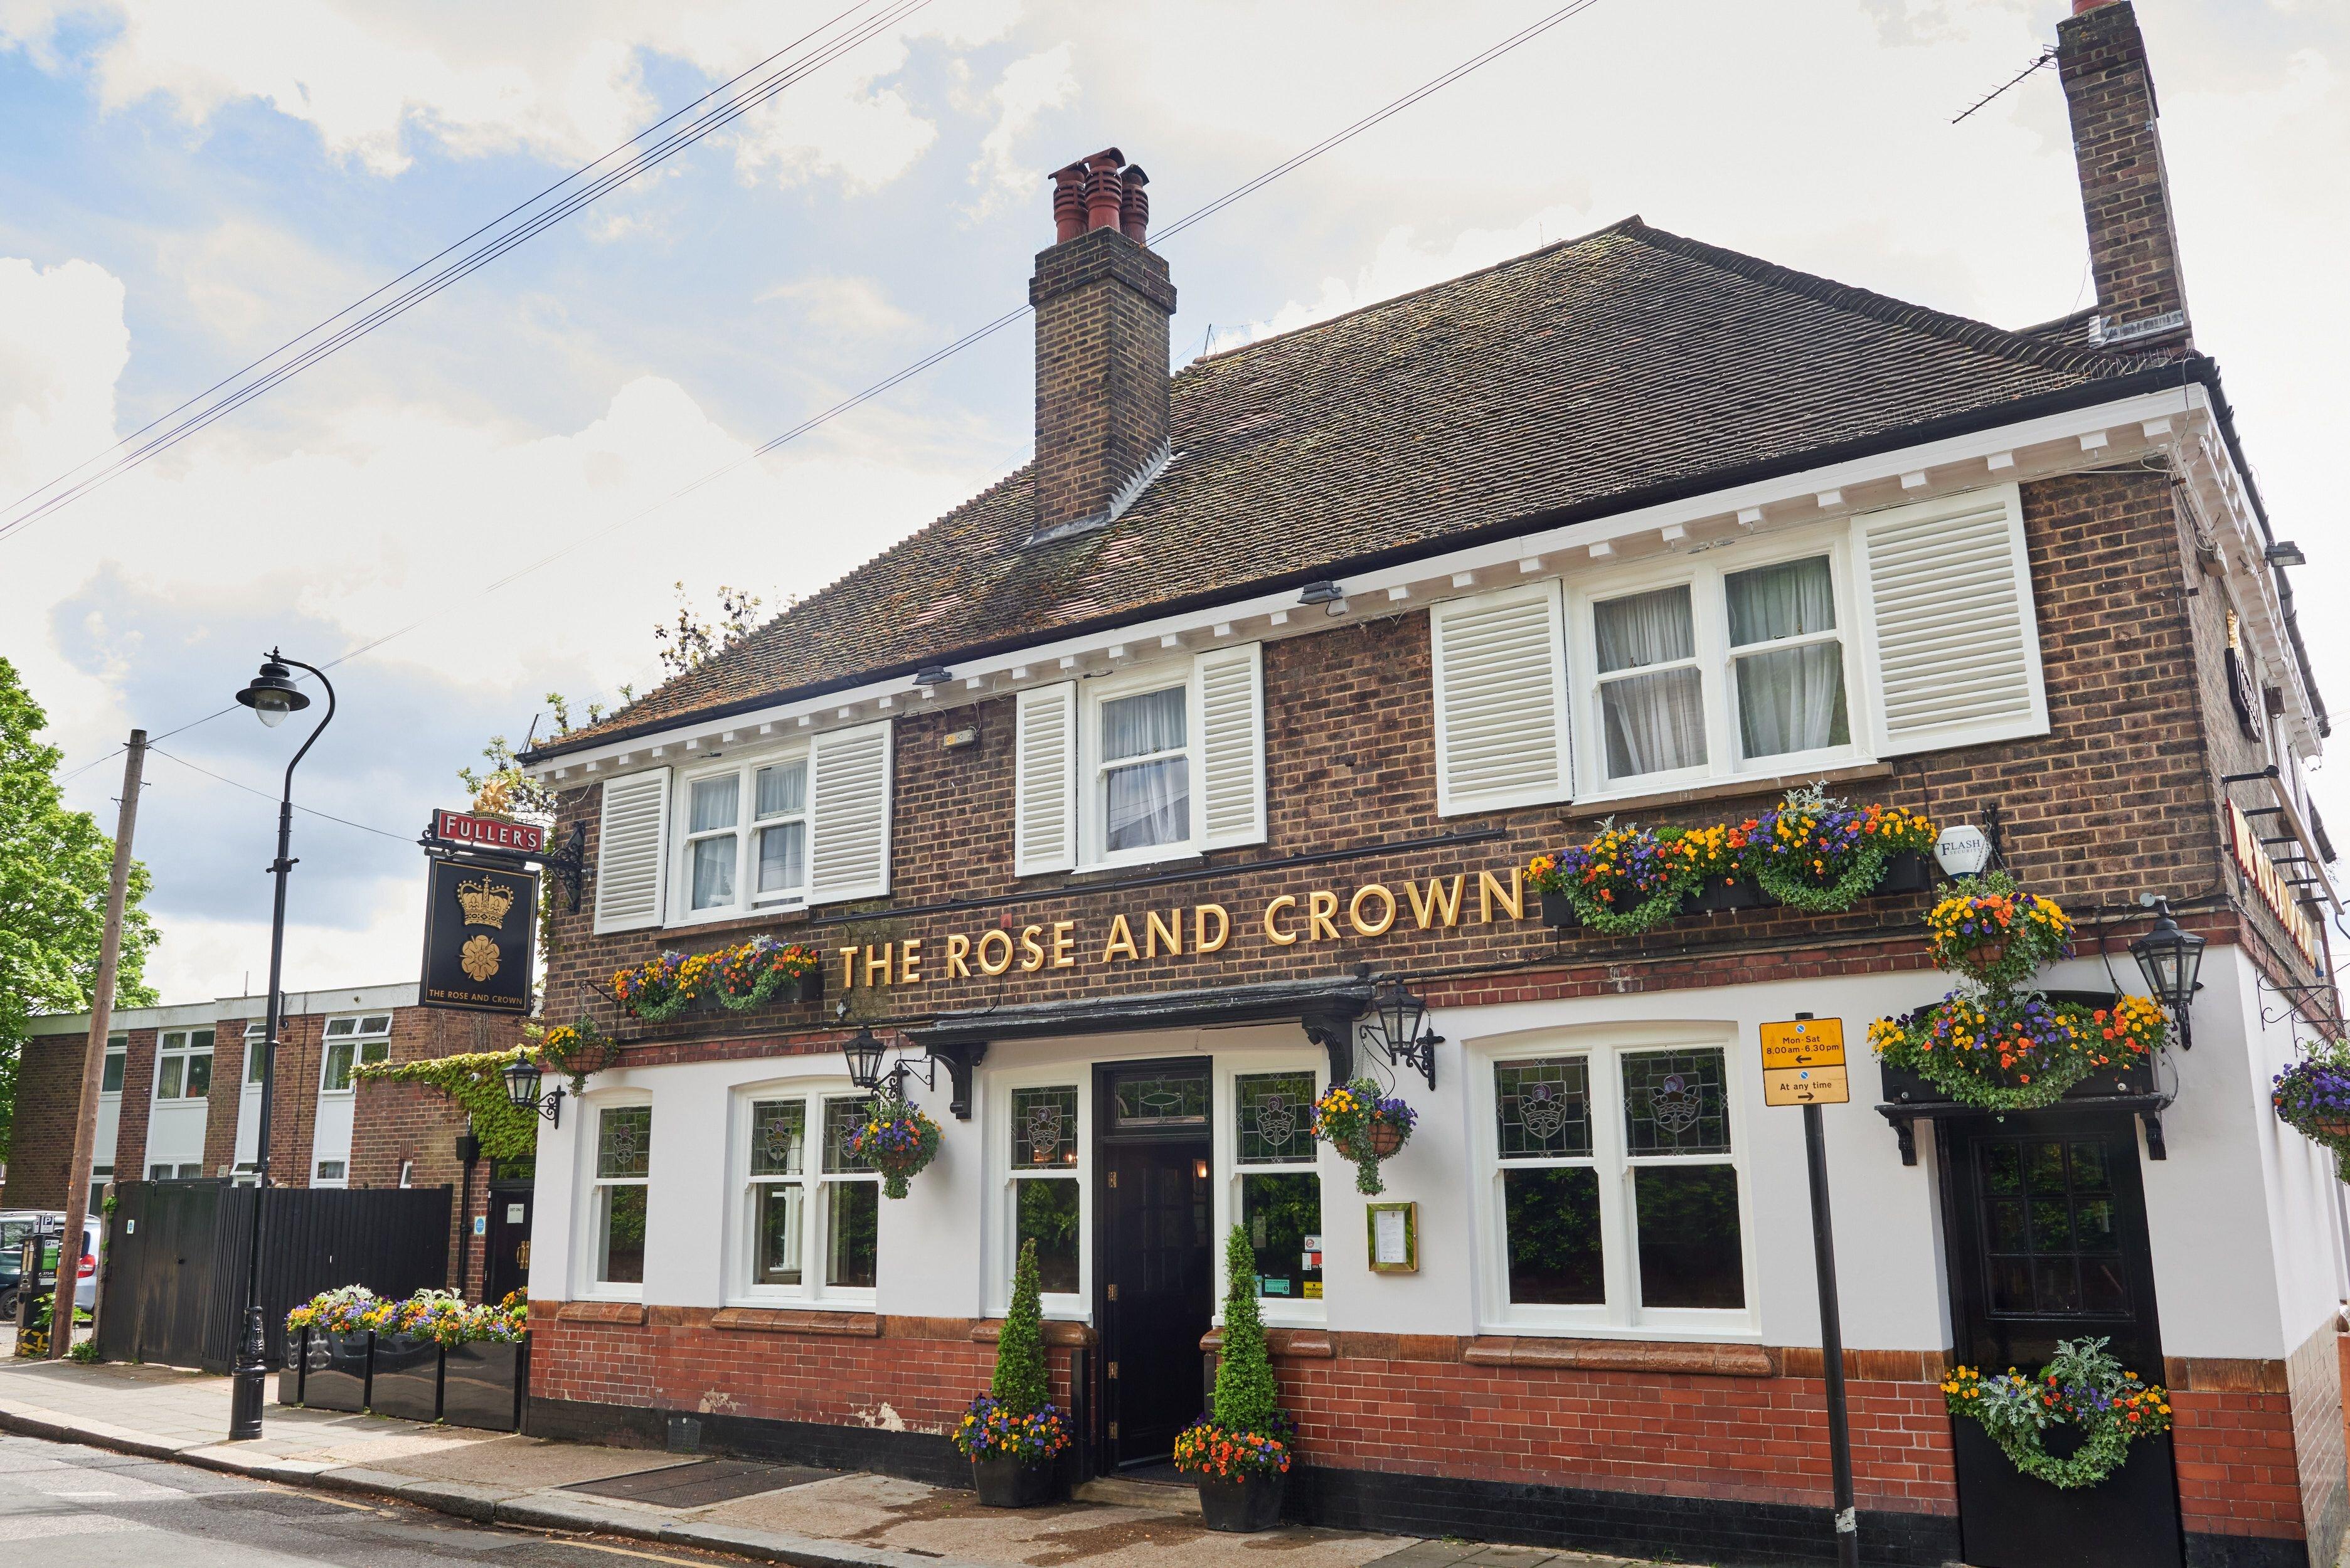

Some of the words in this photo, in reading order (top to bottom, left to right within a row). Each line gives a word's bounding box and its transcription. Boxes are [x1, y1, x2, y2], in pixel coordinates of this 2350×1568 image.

[445, 815, 537, 847] FULLER'S
[1940, 839, 1980, 856] FLASH
[839, 939, 921, 988] THE
[947, 921, 1075, 979] ROSE
[1102, 904, 1230, 963] AND
[1263, 867, 1524, 946] CROWN
[429, 989, 445, 997] THE
[447, 991, 469, 1000] ROSE
[471, 993, 489, 1002] AND
[492, 995, 523, 1005] CROWN
